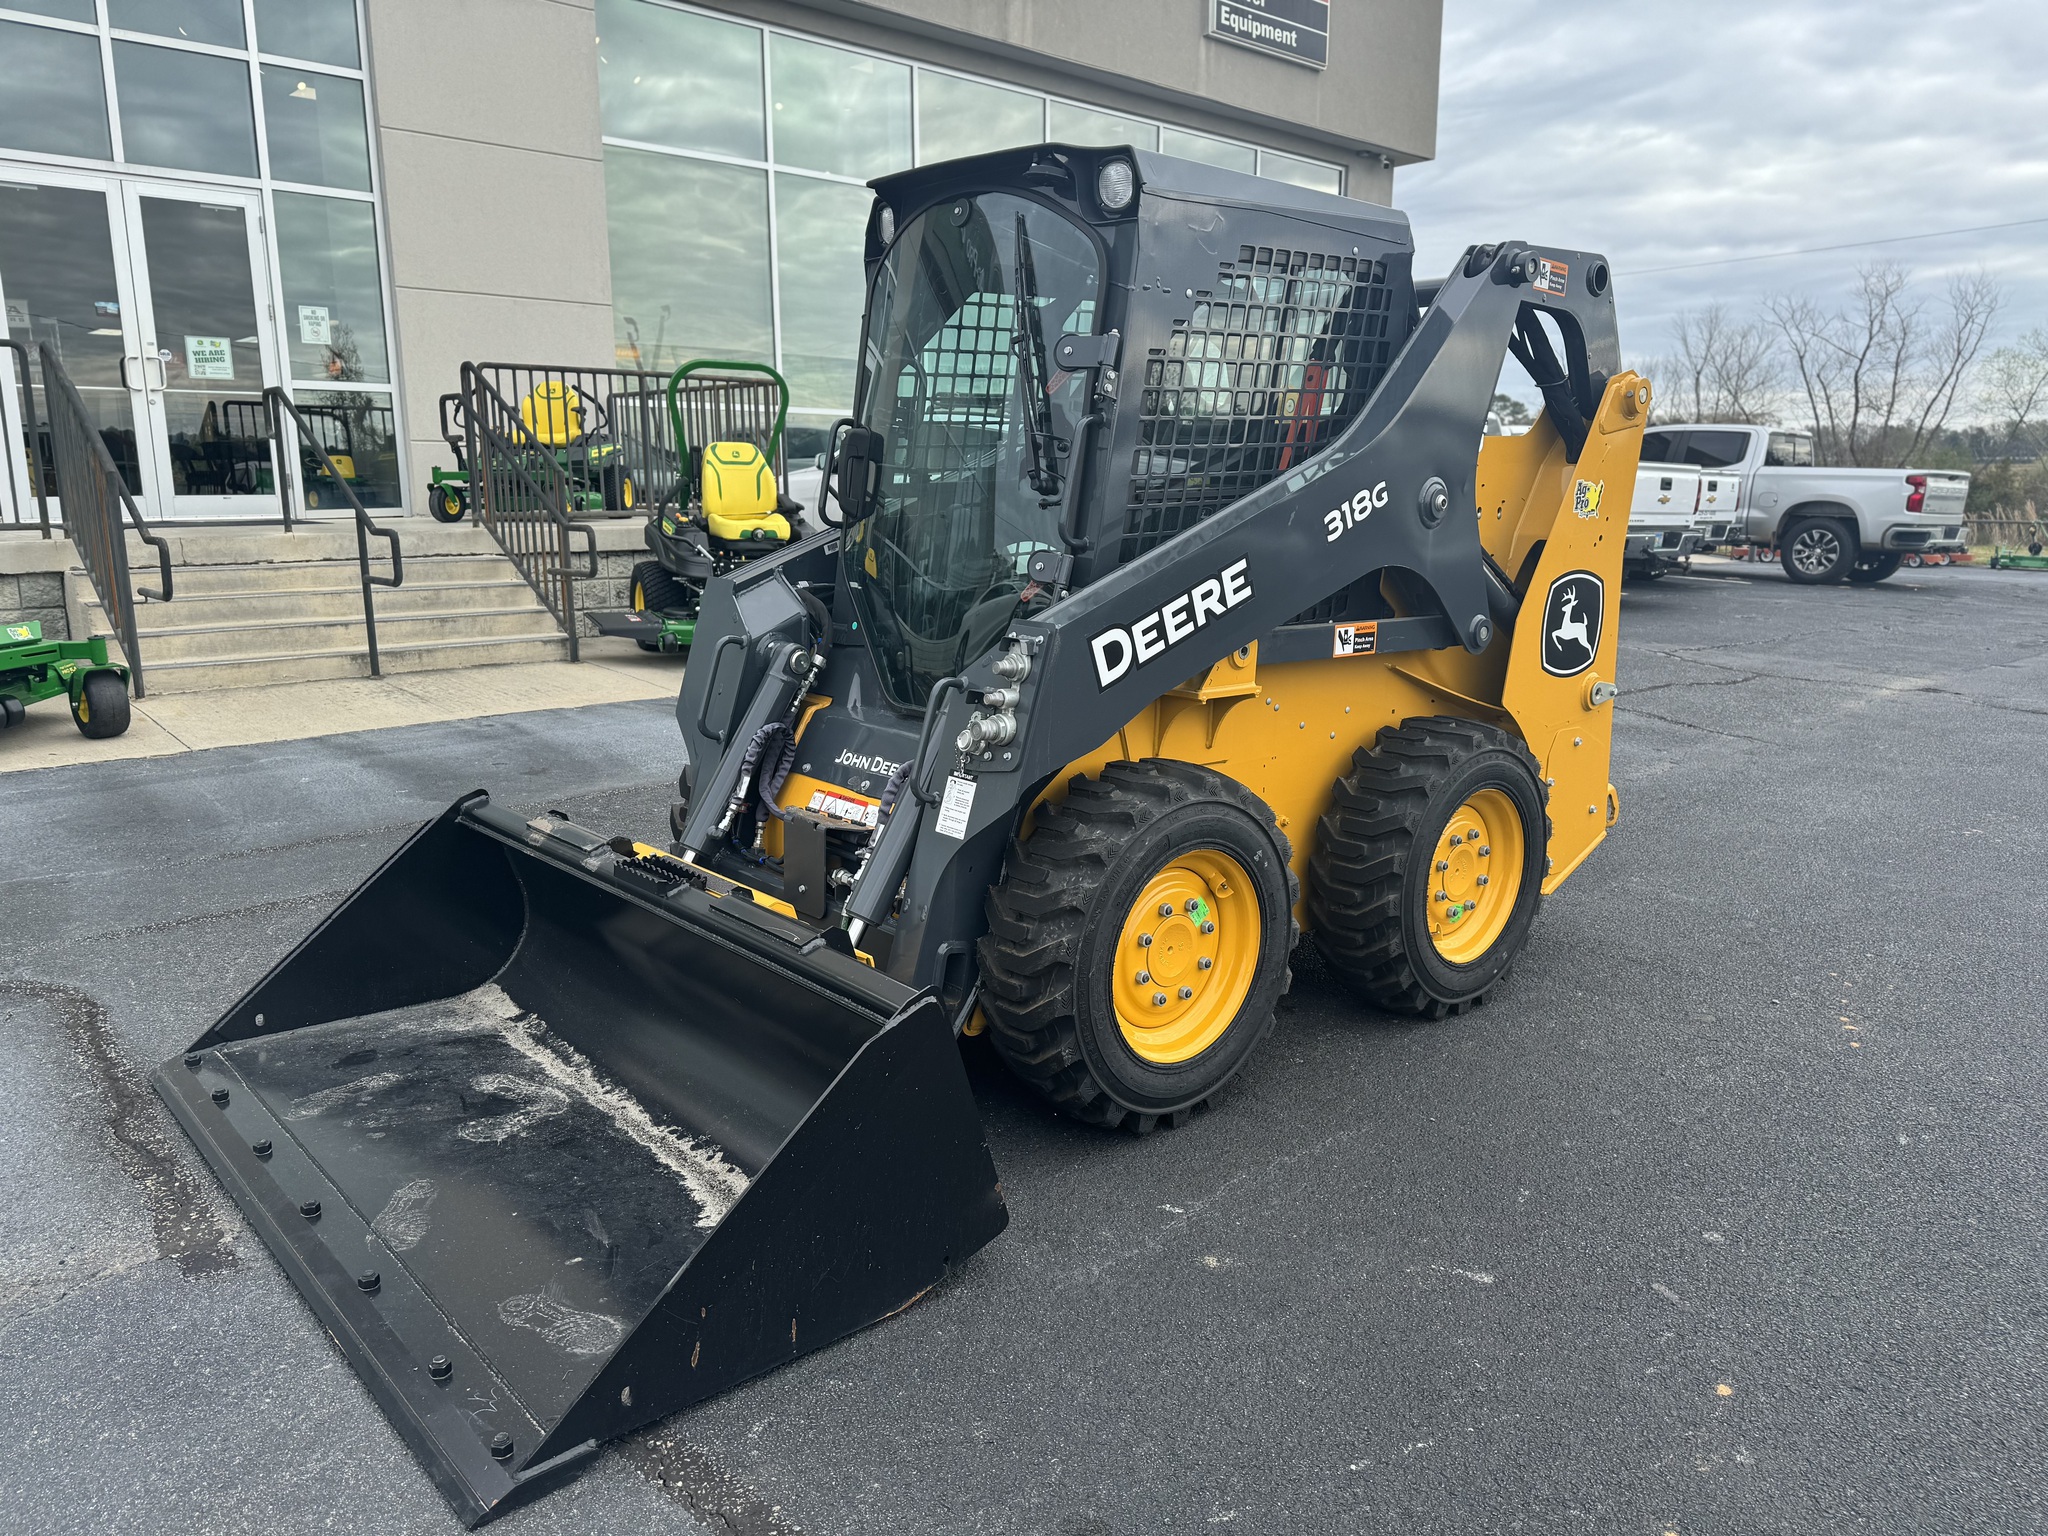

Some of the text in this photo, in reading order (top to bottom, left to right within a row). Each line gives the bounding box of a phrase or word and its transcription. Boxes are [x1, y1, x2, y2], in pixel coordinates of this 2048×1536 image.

[1221, 5, 1297, 47] Equipment
[194, 356, 226, 364] HIRING
[1324, 480, 1389, 543] 318G
[1575, 496, 1589, 510] Pro
[1090, 558, 1253, 688] DEERE
[835, 749, 900, 776] JOHN DEE
